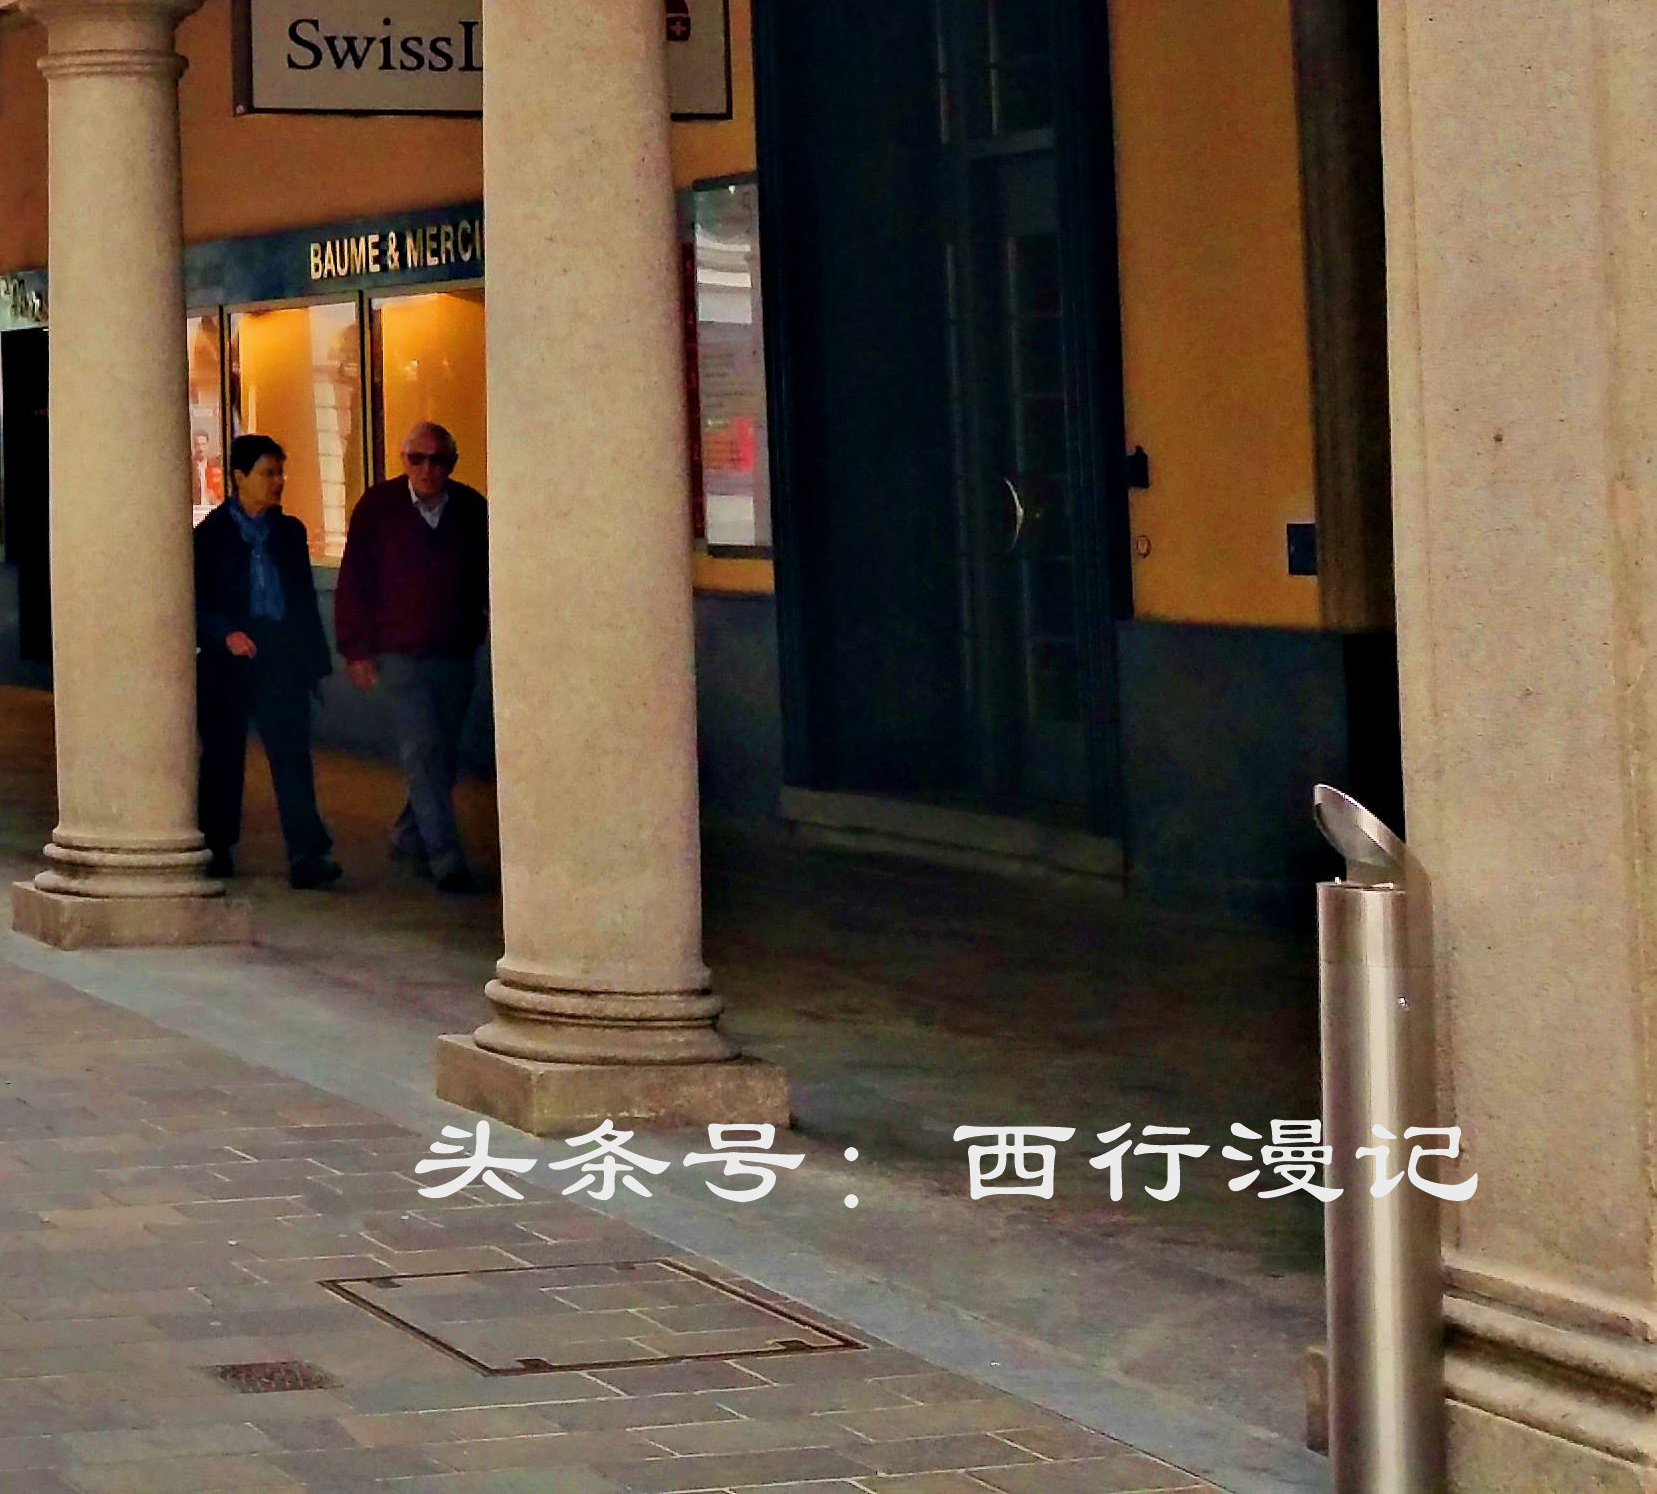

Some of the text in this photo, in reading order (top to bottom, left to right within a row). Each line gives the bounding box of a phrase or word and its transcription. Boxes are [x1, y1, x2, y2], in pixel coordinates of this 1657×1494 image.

[310, 219, 484, 281] BAUME & MERCI
